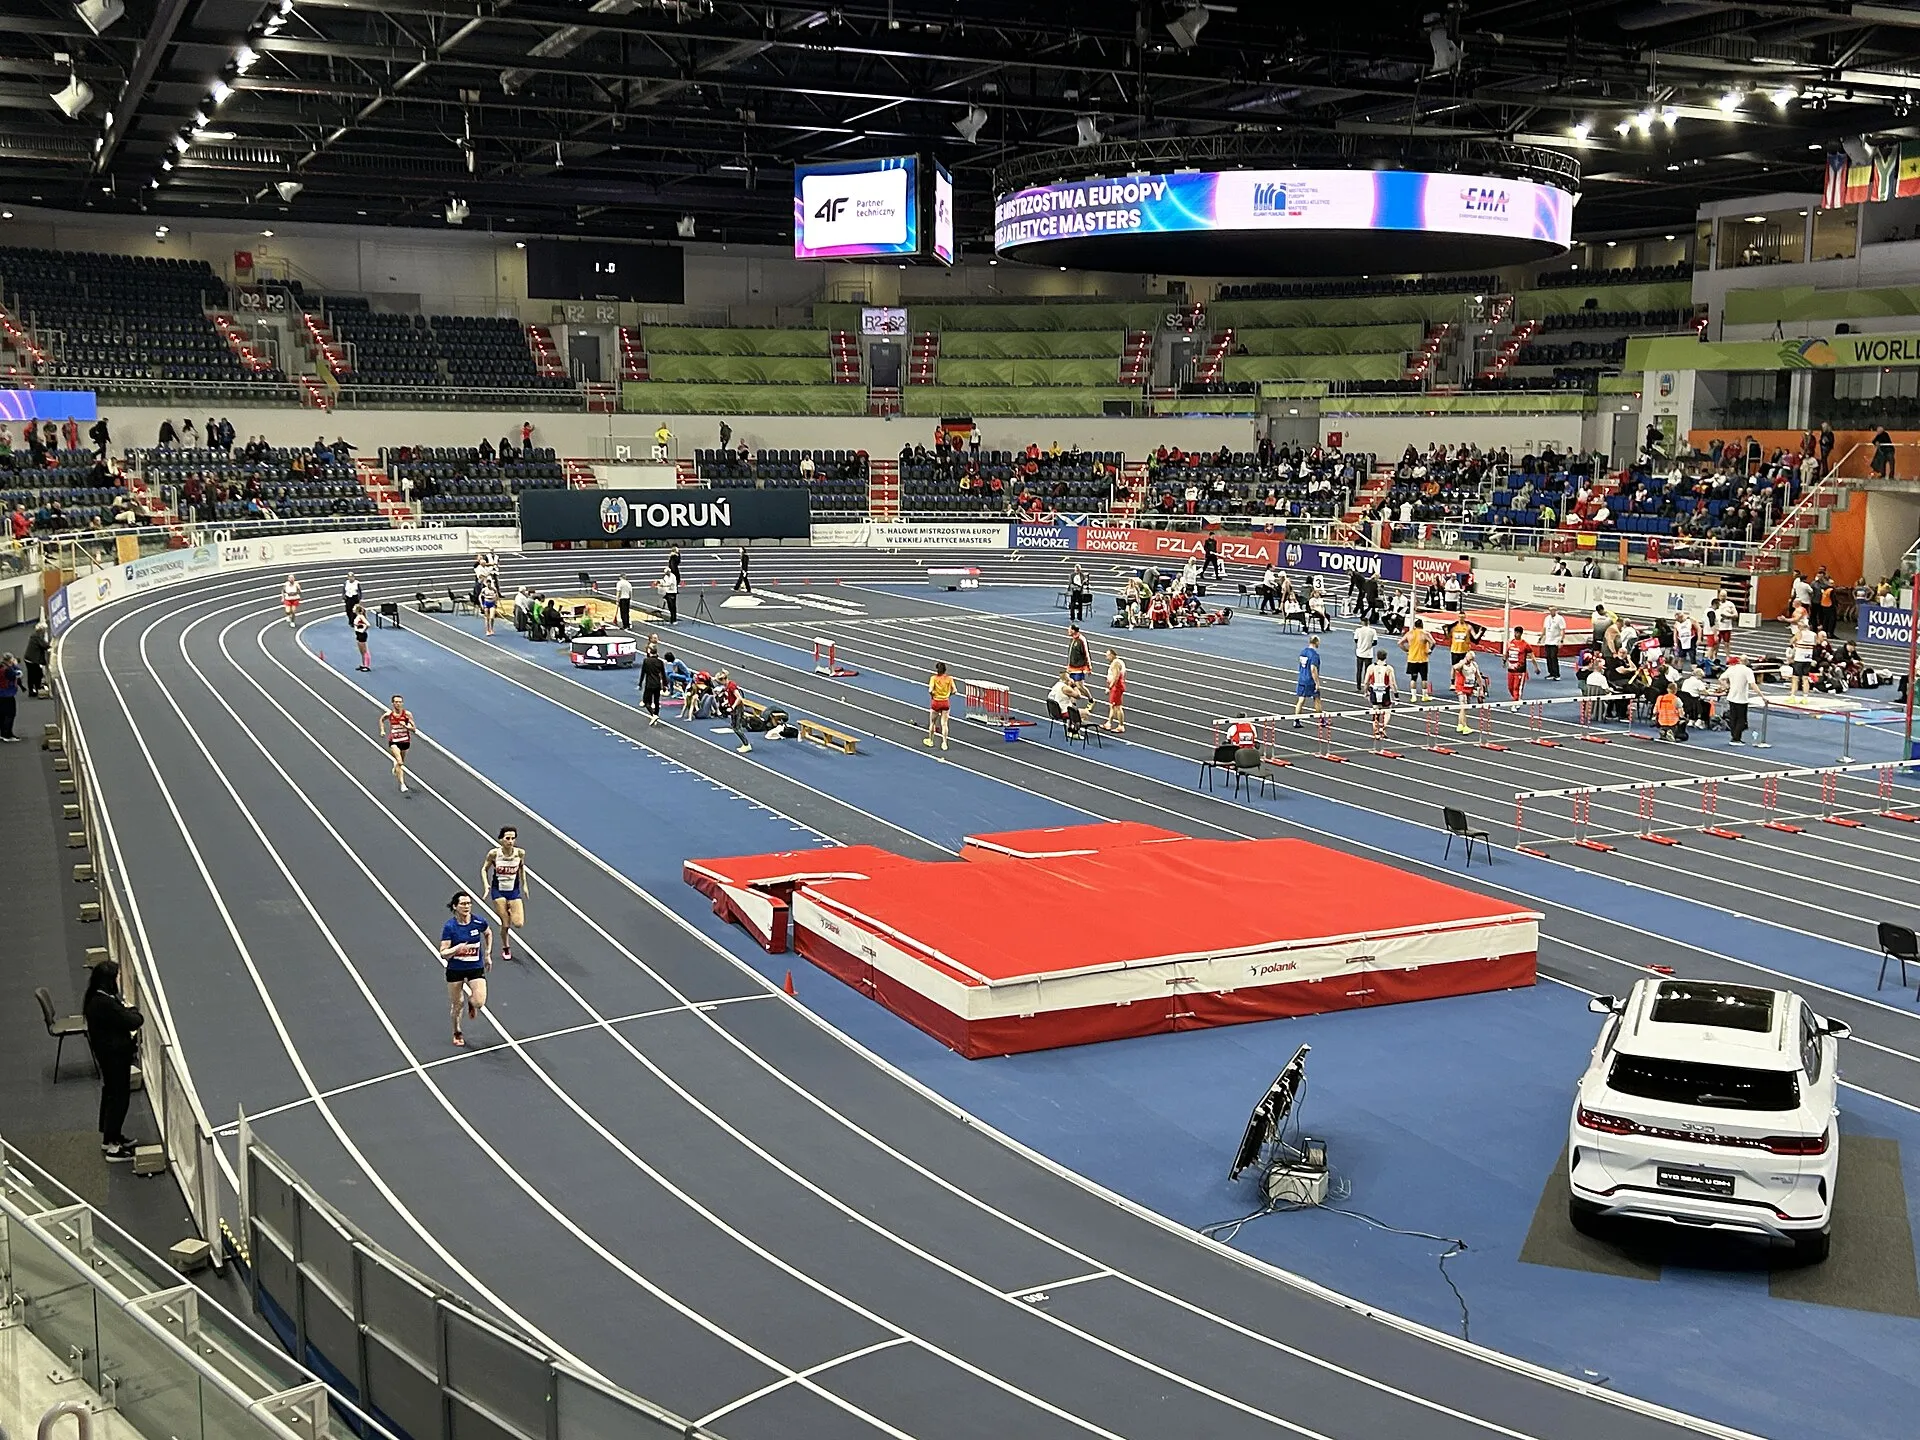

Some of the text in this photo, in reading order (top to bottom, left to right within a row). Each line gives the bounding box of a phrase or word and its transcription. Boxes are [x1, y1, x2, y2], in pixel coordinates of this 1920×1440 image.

[856, 199, 884, 208] Partner
[1004, 187, 1086, 219] MISTRZOSTWA
[1089, 181, 1166, 207] EUROPY
[1466, 188, 1505, 212] EMA
[856, 207, 896, 217] techniczny
[1005, 214, 1058, 242] ATLETYCE
[1059, 208, 1142, 234] MASTERS
[865, 316, 882, 329] R2
[1166, 313, 1183, 327] S2
[616, 445, 631, 459] P1
[629, 497, 731, 528] TORUŃ
[353, 536, 389, 544] EUROPEAN
[390, 534, 421, 543] MASTERS
[422, 533, 458, 541] ATHLETICS
[1016, 526, 1061, 538] KUJAWY
[1086, 529, 1131, 541] KUJAWY
[1439, 529, 1458, 545] VIP
[359, 543, 443, 554] CHAMPIONSHIPS INDOOR
[1016, 537, 1070, 548] POMORZE
[1086, 540, 1139, 552] POMORZE
[1156, 537, 1206, 555] PZLA
[1221, 542, 1270, 561] PZLA
[1318, 553, 1382, 574] TORUŃ
[1412, 559, 1452, 572] KUJAWY
[1315, 578, 1322, 588] 3
[1869, 610, 1913, 628] KUJAW
[1260, 961, 1297, 976] polanik
